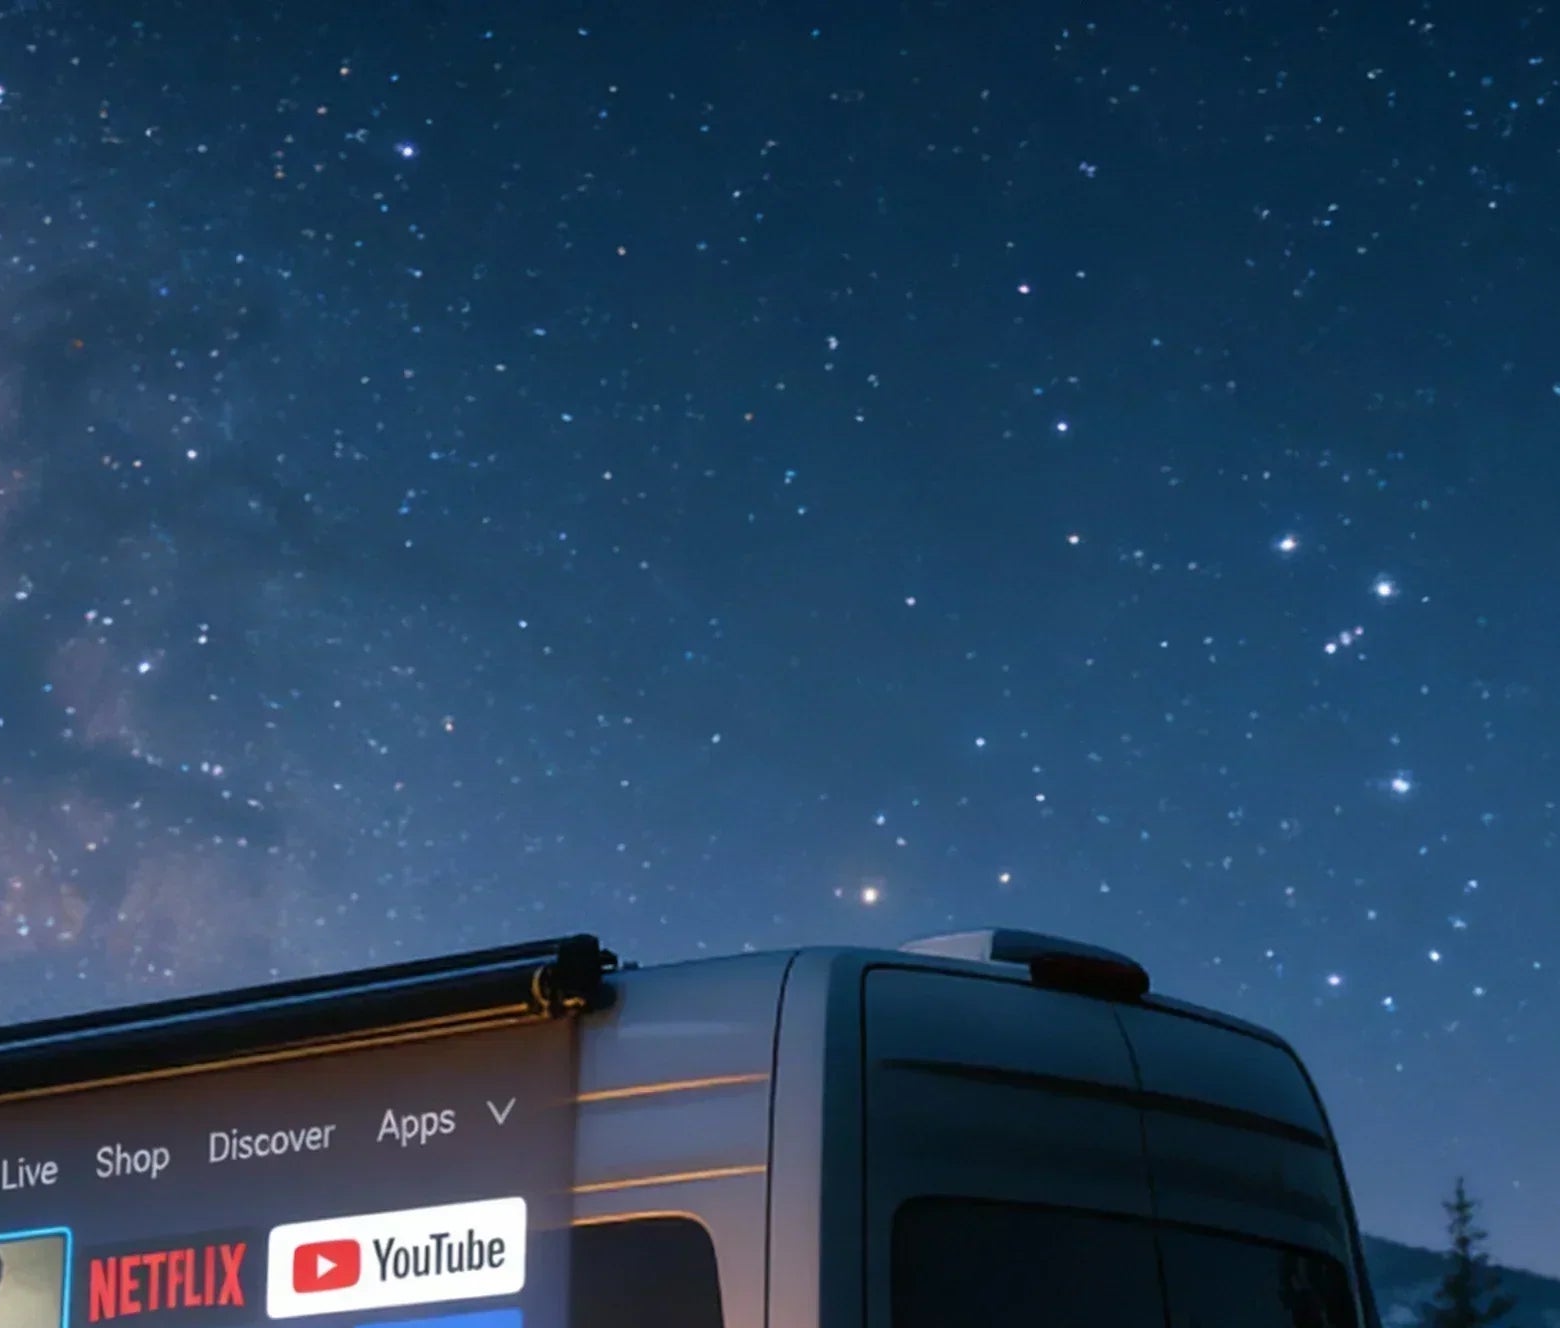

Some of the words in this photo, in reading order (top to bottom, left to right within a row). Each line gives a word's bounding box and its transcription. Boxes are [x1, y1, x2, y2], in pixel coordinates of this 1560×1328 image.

[208, 1122, 336, 1163] Discover
[377, 1106, 457, 1146] Apps
[1, 1157, 59, 1189] Live
[96, 1141, 171, 1178] Shop
[373, 1227, 506, 1281] YouTube
[88, 1240, 247, 1322] NETFLIX
